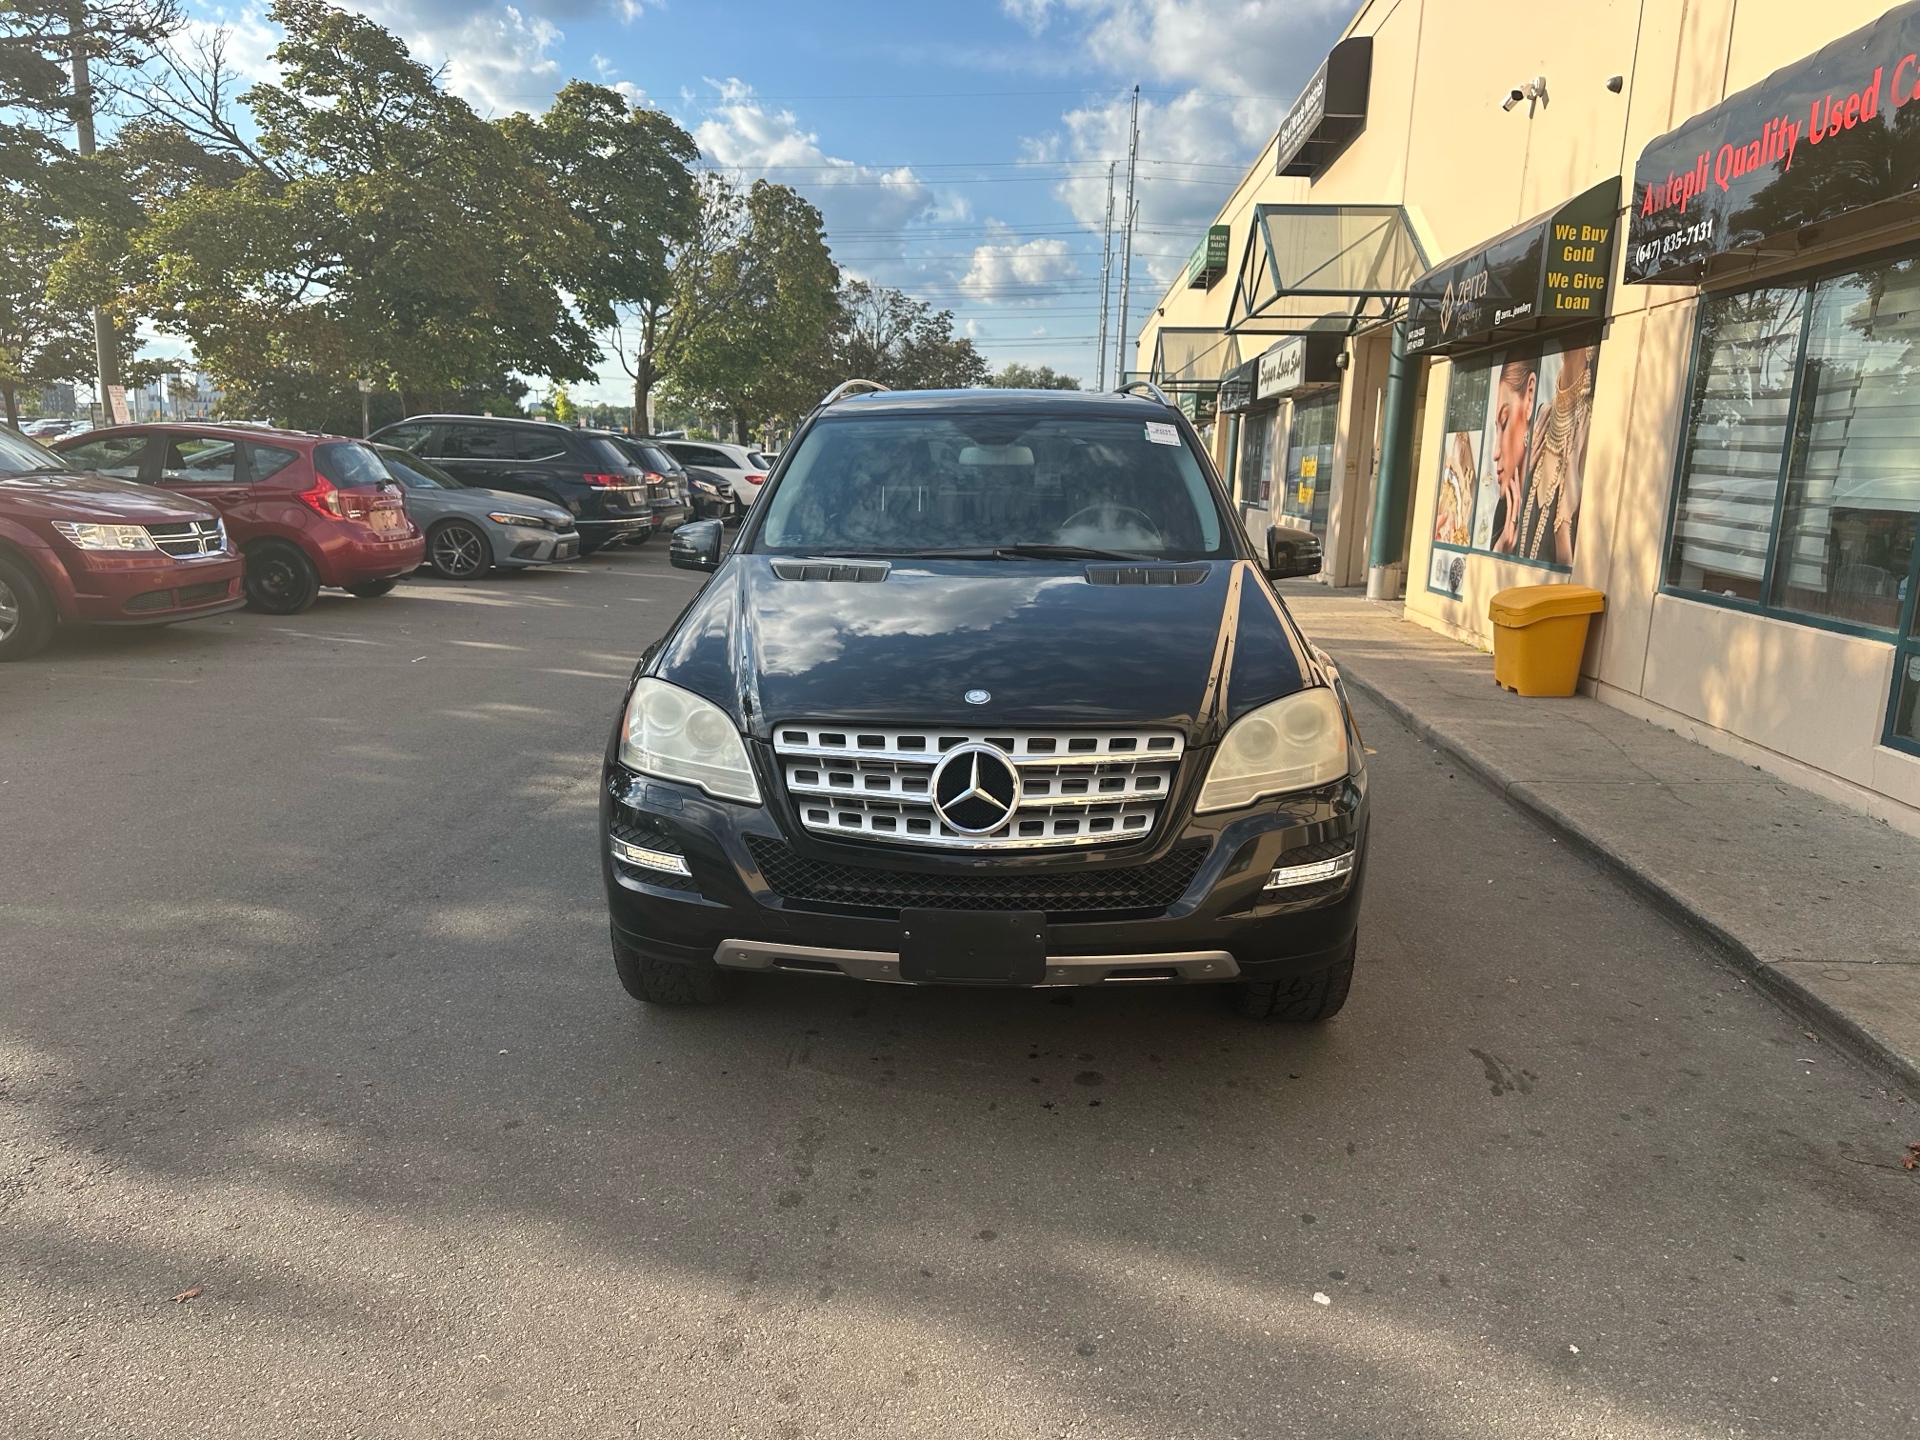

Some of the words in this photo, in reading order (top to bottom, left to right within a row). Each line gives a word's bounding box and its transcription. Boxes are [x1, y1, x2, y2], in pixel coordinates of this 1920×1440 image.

[1641, 151, 1711, 218] Antepli
[1714, 114, 1803, 192] Quality
[1808, 67, 1883, 145] Used
[1555, 225, 1576, 241] We
[1581, 225, 1608, 243] Buy
[1635, 238, 1661, 267] (647)
[1663, 218, 1714, 254] 835-7131
[1563, 246, 1595, 262] Gold
[1548, 272, 1569, 289] We
[1573, 273, 1605, 290] Give
[1555, 294, 1590, 310] Loan
